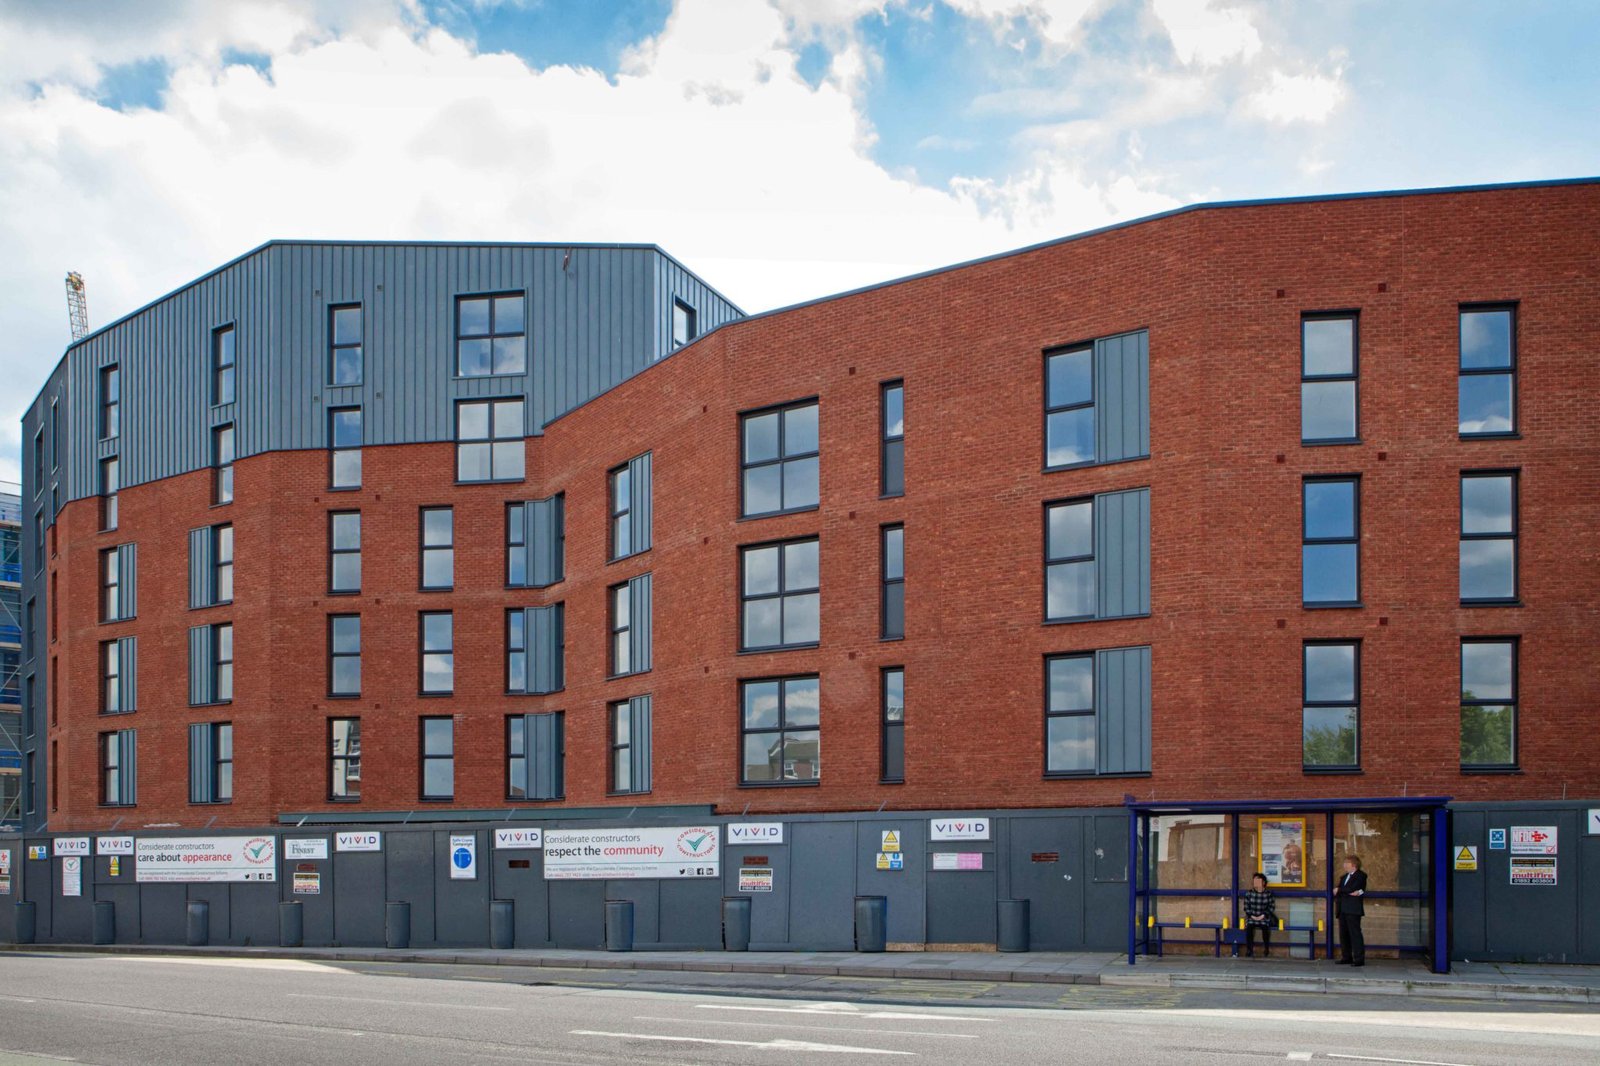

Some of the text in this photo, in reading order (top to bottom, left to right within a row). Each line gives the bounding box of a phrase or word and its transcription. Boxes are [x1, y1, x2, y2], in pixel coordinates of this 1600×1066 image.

[732, 827, 779, 836] VIVID
[935, 823, 985, 832] VIVID
[339, 836, 377, 844] VIVID
[499, 832, 539, 841] VIVID
[544, 834, 641, 844] Considerate constructors
[56, 841, 87, 849] VIVID
[100, 840, 132, 848] VIVID
[137, 842, 215, 851] Considerate constructors
[545, 844, 664, 859] respect the community
[137, 852, 232, 864] care about appearance
